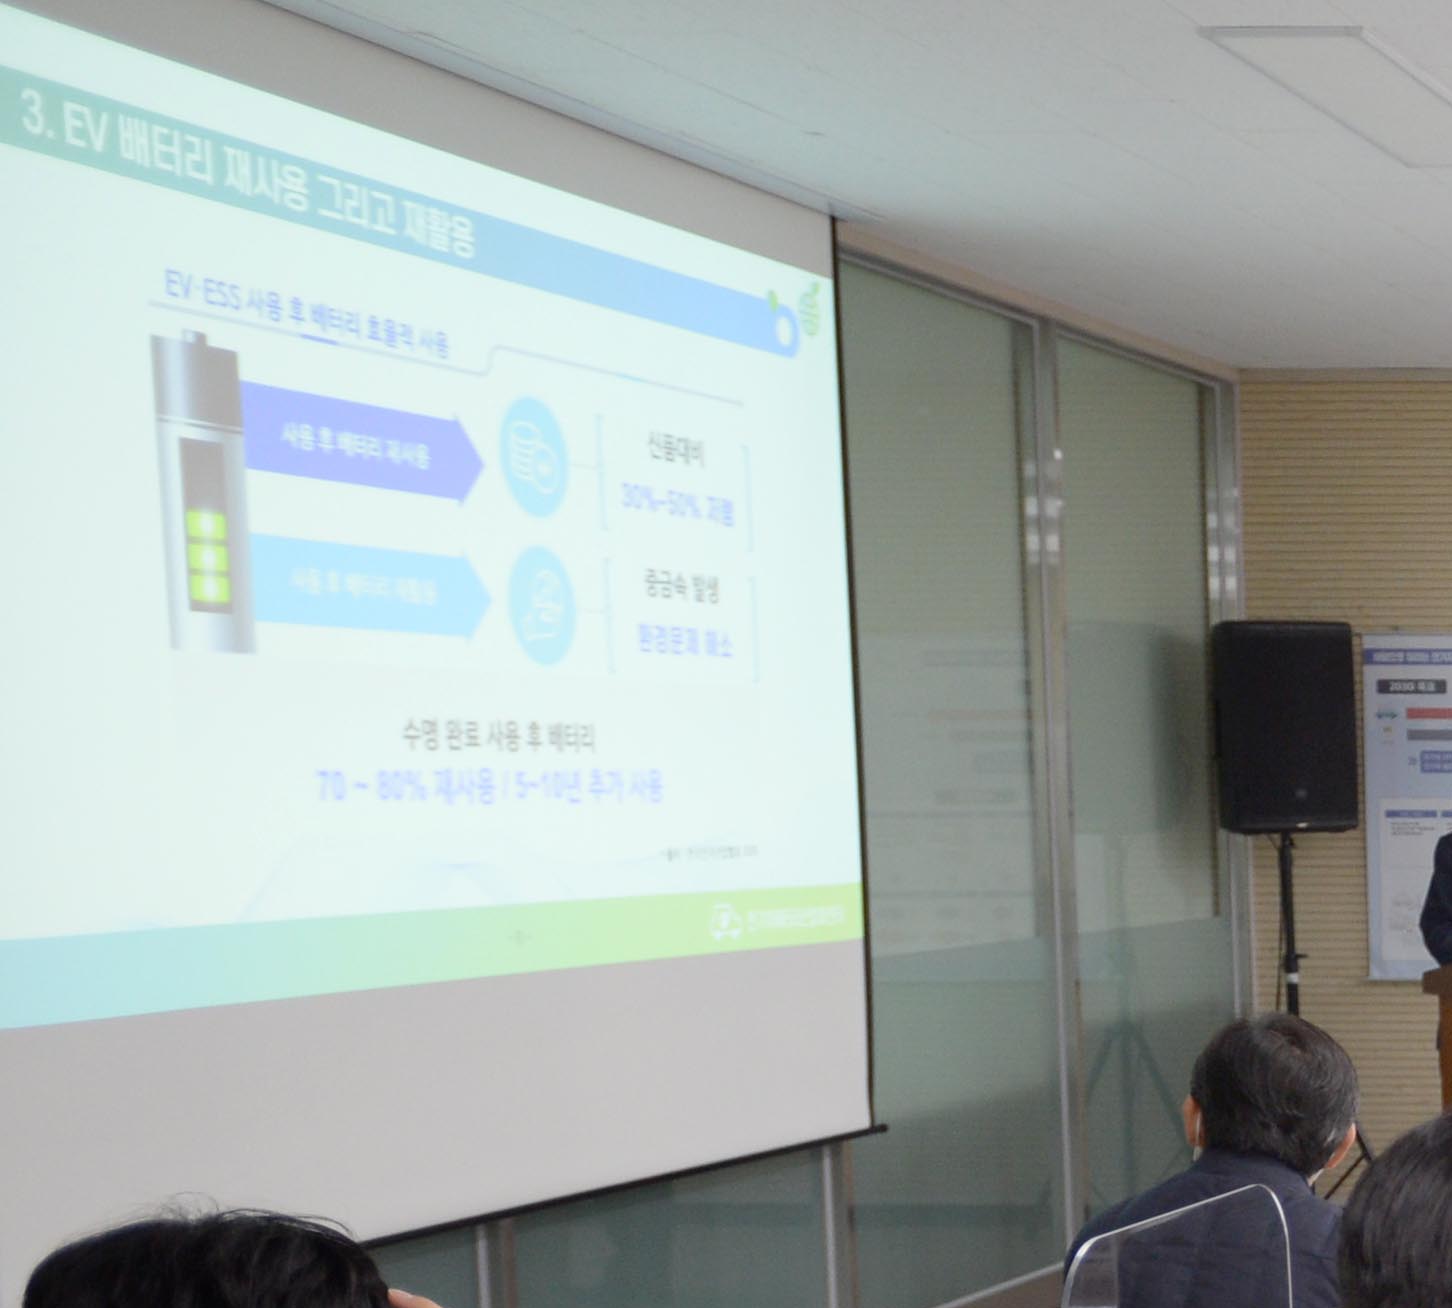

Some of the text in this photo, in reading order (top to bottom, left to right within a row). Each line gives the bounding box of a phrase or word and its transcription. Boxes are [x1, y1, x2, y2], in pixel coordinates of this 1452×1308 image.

[20, 88, 476, 260] 3. EV 배터리 재사용 그리고 재활용
[310, 302, 361, 338] 배터리
[403, 717, 596, 754] 수명 완료 사용 후 배터리
[315, 768, 346, 801] 70
